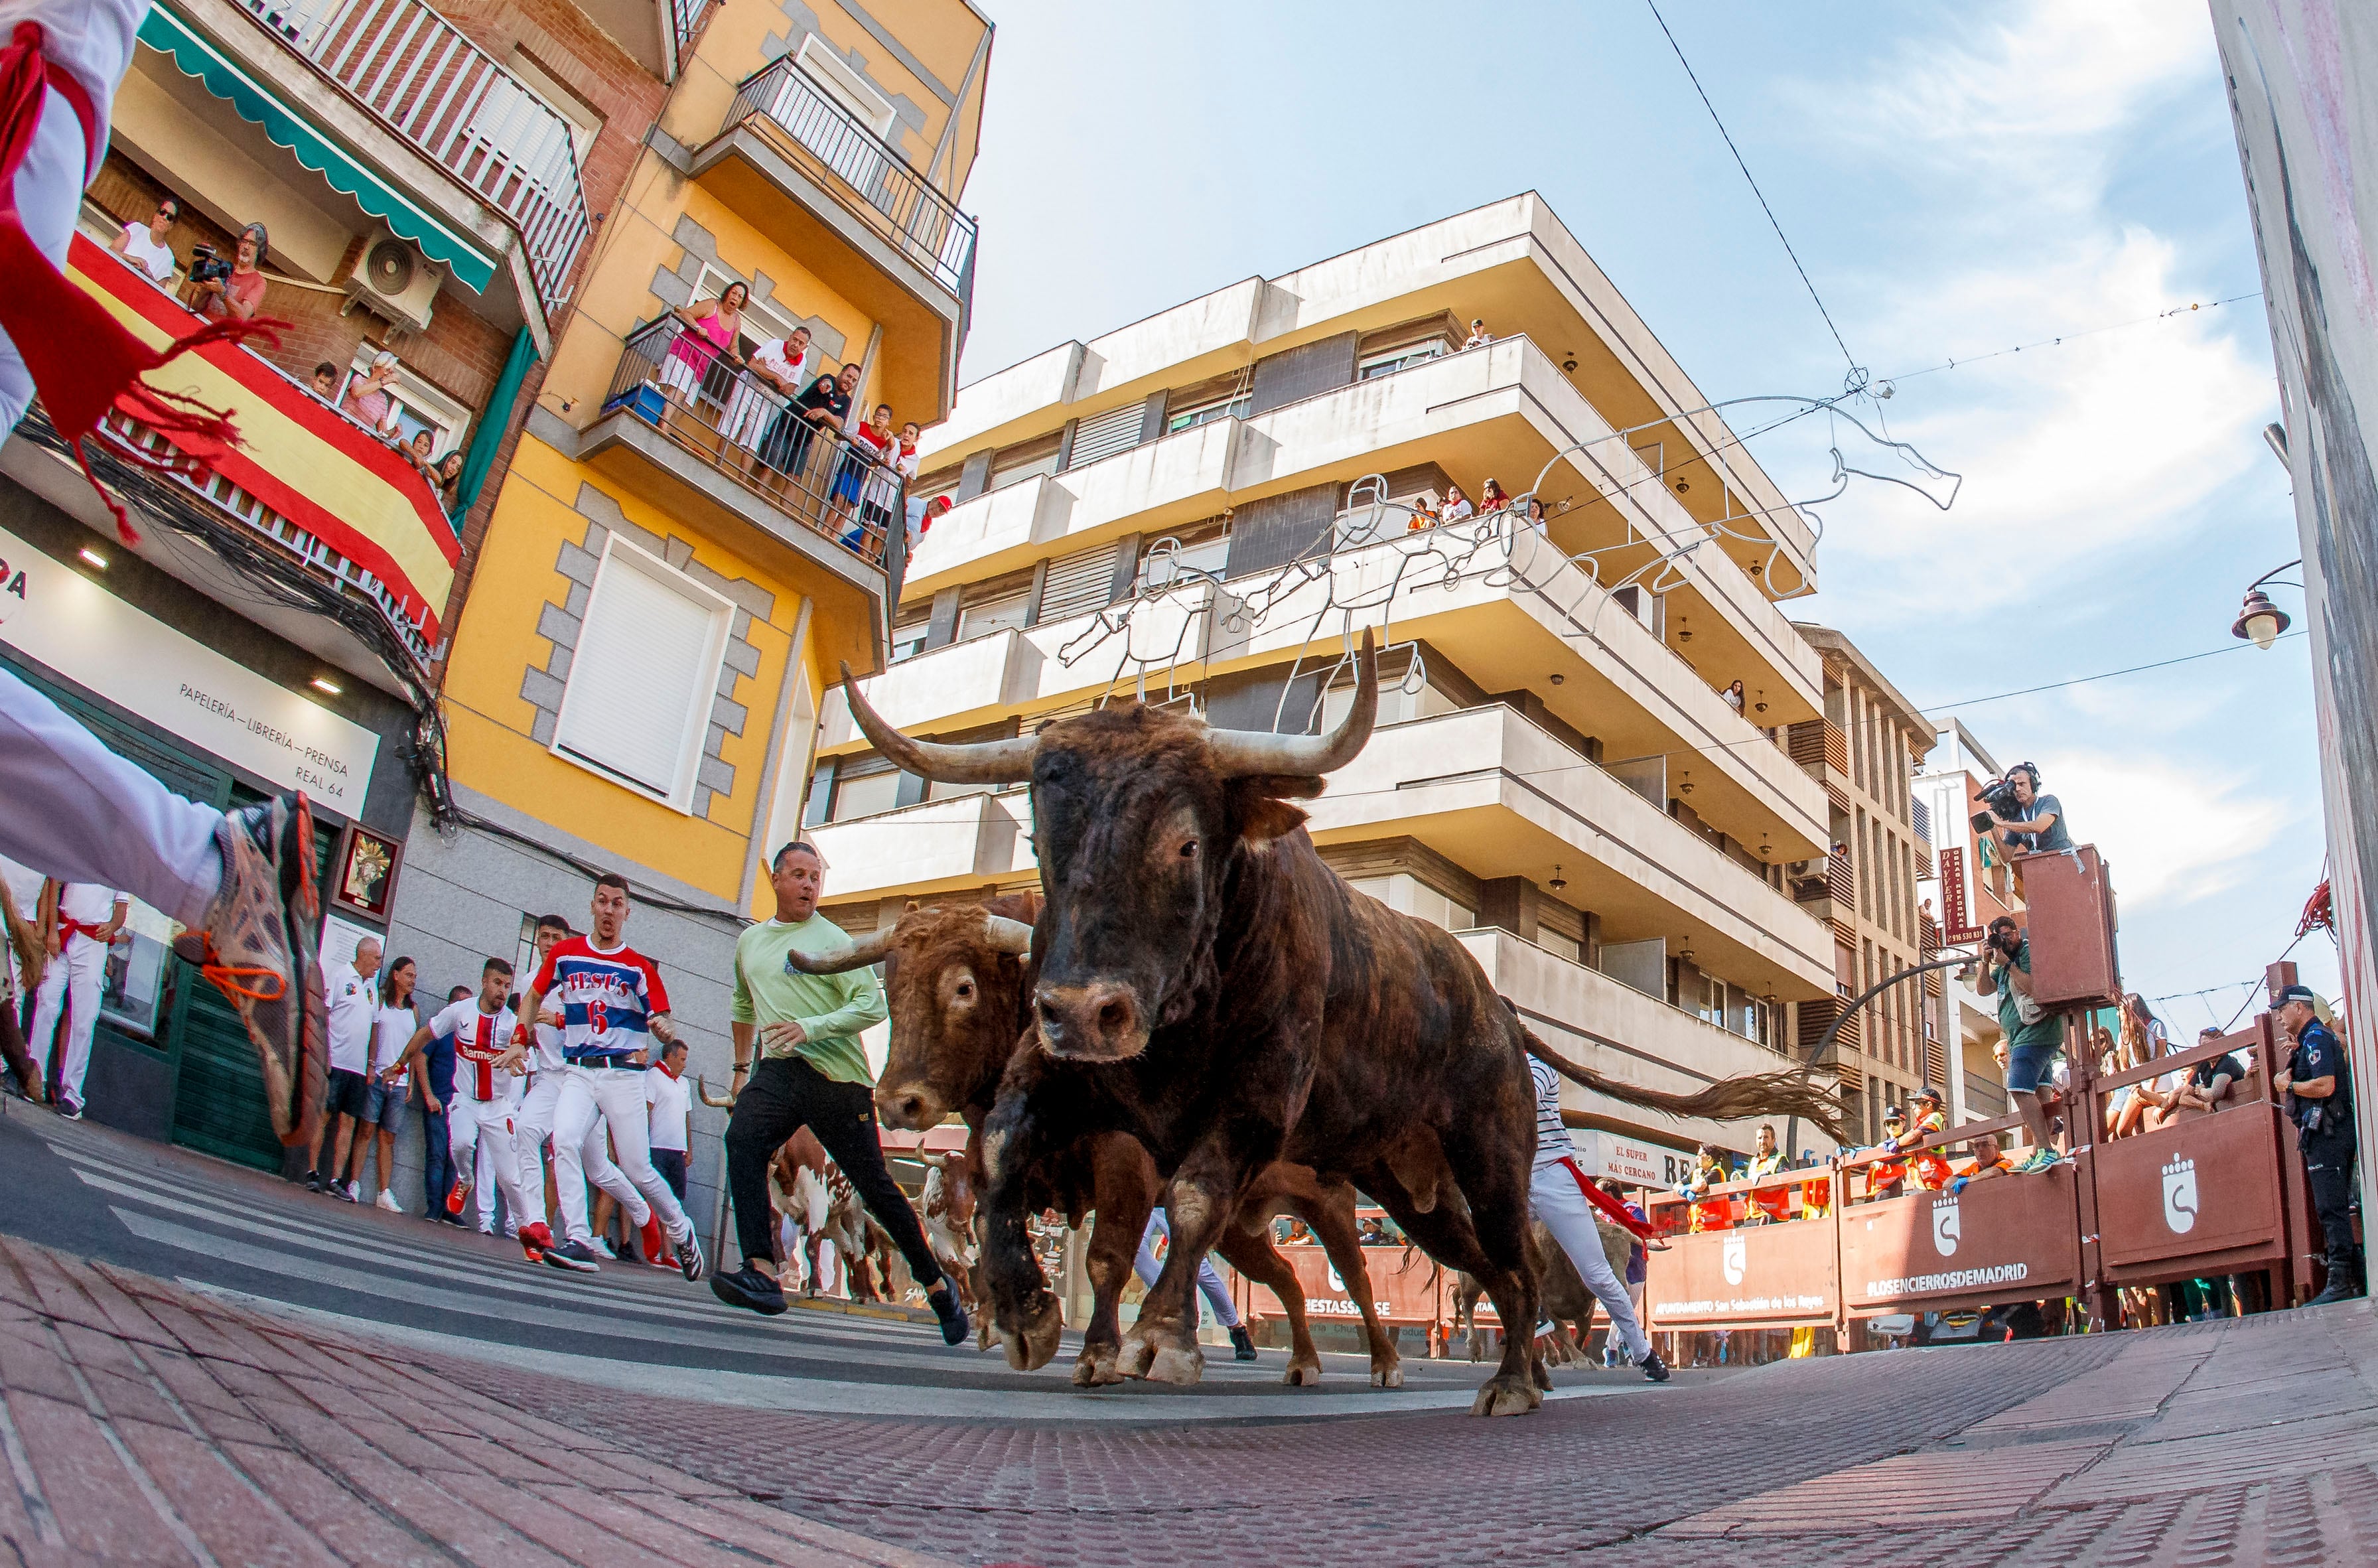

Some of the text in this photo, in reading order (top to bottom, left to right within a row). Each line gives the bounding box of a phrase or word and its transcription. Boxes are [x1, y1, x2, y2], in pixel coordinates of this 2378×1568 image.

[296, 766, 344, 798] REAL 64
[568, 972, 629, 997] JESÚS
[587, 999, 608, 1035] 6
[462, 1045, 502, 1060] Barmen
[1616, 1147, 1647, 1162] EL SUPER
[1608, 1160, 1656, 1181] MÁS CERCANO
[1664, 1155, 1699, 1184] RE
[1867, 1263, 2028, 1297] #LOSENCIERROSDEMADRID
[1655, 1295, 1824, 1315] AYUNTAMIENTO San Sebastián de los Reyes
